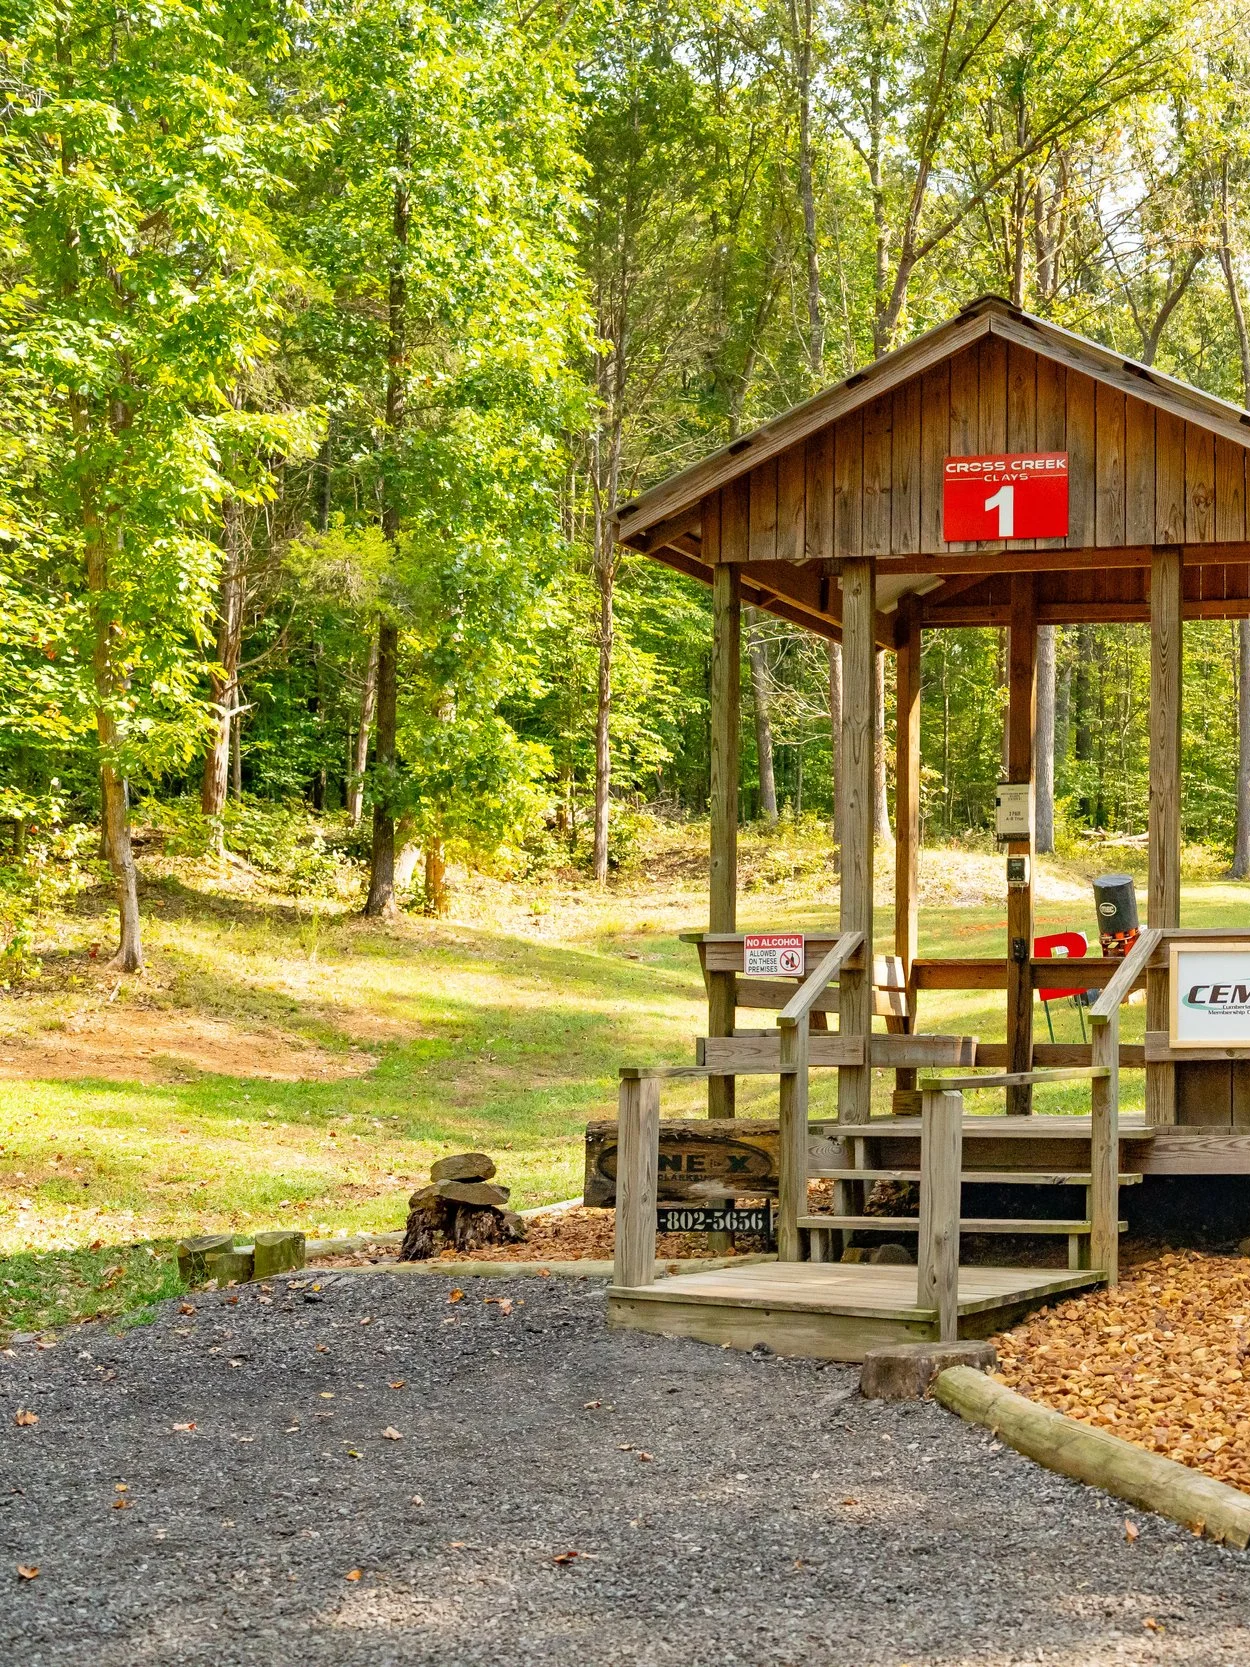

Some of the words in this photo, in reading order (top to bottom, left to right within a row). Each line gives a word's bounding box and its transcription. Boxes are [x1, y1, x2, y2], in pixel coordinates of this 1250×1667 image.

[945, 461, 1006, 473] CROSS
[1011, 459, 1066, 470] CREEK
[983, 472, 1029, 482] CLAYS
[984, 485, 1014, 537] 1
[746, 939, 759, 947] NO
[761, 938, 802, 946] ALCOHOL
